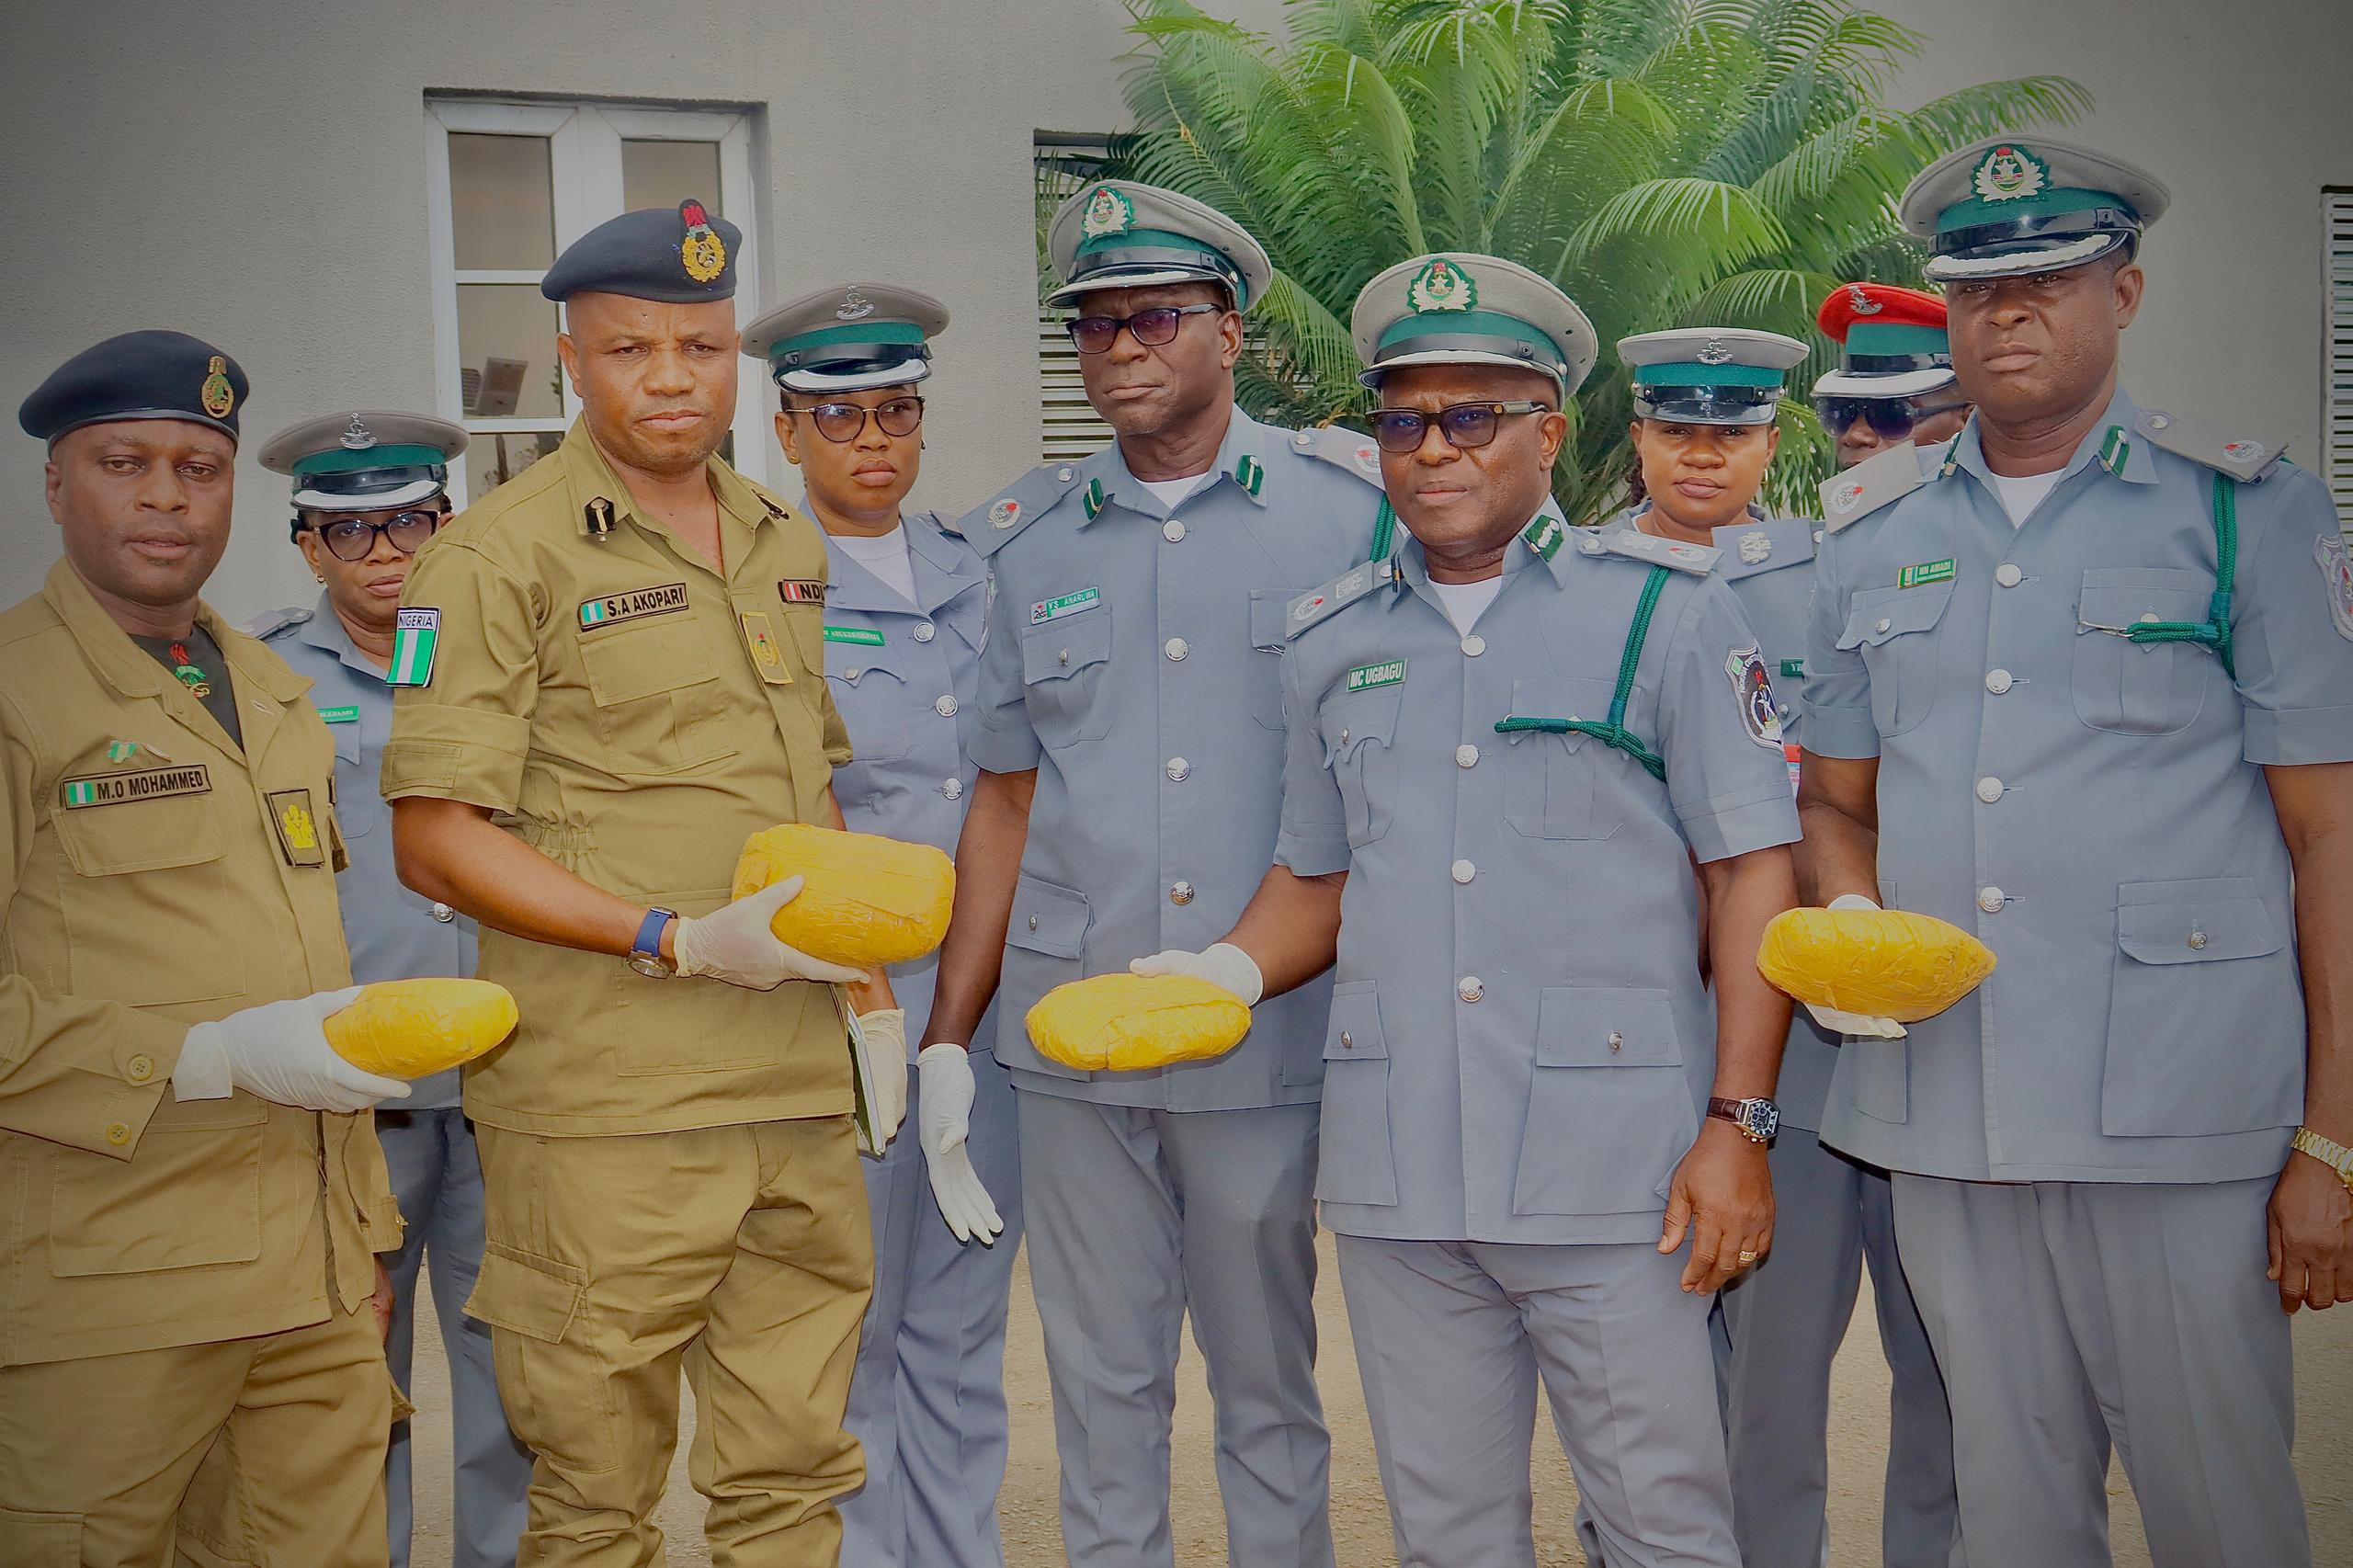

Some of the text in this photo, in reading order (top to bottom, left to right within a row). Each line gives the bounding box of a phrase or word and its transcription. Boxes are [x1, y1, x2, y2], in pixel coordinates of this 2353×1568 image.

[607, 587, 685, 617] S.A AKOPARI
[398, 615, 434, 627] NIGERIA
[1349, 662, 1404, 687] MC UGBAGU
[97, 770, 203, 801] M.O MOHAMMED
